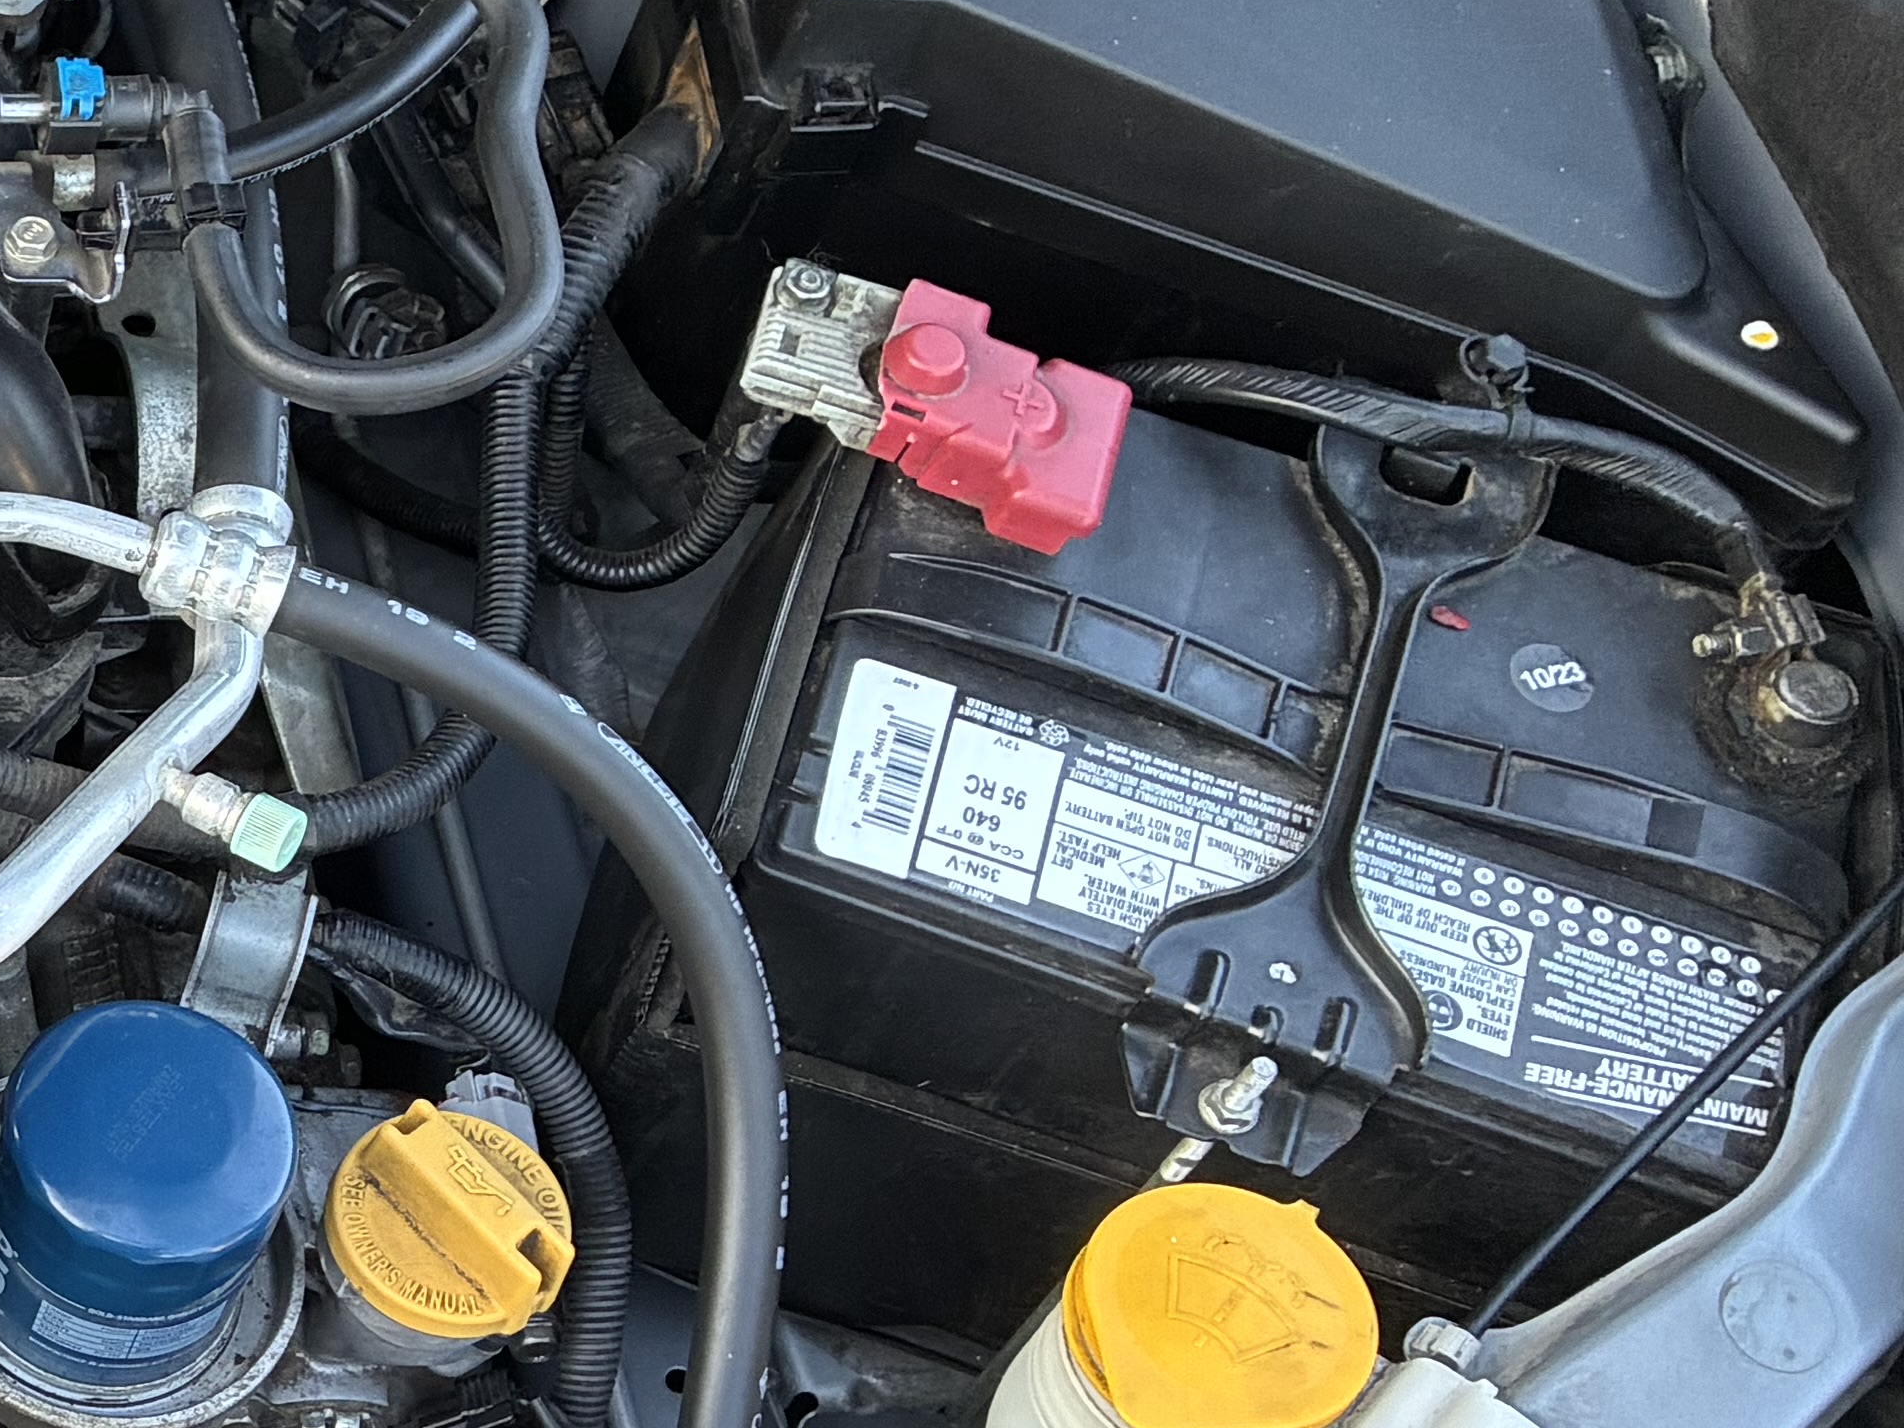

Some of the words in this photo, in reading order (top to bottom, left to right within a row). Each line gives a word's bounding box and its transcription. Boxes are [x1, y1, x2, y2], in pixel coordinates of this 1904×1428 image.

[297, 565, 350, 595] EH
[1519, 657, 1588, 696] 10/23
[988, 713, 1034, 736] BATTERY
[992, 734, 1021, 751] 12V
[961, 772, 997, 801] RC
[999, 784, 1028, 810] 95
[960, 805, 1002, 832] 640
[1114, 817, 1146, 836] OPEN
[1146, 816, 1171, 832] NOT
[1146, 829, 1171, 844] NOT
[1173, 825, 1192, 840] DO
[987, 839, 1025, 860] CCA
[1053, 840, 1106, 868] MEDICAL
[1090, 840, 1121, 860] HELP
[1172, 837, 1190, 851] DO
[1202, 834, 1284, 870] NSTRUCTIONS.
[943, 853, 1001, 883] 35N-V
[1050, 853, 1074, 870] GET
[1231, 855, 1253, 871] ALL
[965, 885, 994, 902] PART
[1081, 873, 1128, 898] WATER.
[1077, 885, 1154, 919] MMEDIATELY
[1129, 888, 1161, 908] WITH
[1084, 900, 1116, 919] EYES
[1372, 903, 1396, 919] THE
[1396, 911, 1413, 925] OF
[1415, 906, 1431, 919] OF
[1117, 911, 1149, 931] LUSH
[1414, 917, 1438, 933] OUT
[1432, 912, 1471, 933] REACH
[1439, 926, 1469, 944] KEEP
[1397, 949, 1457, 977] BLINDNESS
[1458, 970, 1493, 989] CAUSE
[1494, 983, 1516, 997] CAN
[1447, 979, 1515, 1012] EXPLOSIVE
[1473, 1004, 1512, 1026] EYES.
[1464, 1017, 1510, 1042] SHIELD
[1596, 1025, 1668, 1058] PROPOSITION
[1594, 1055, 1698, 1092] ATTERY
[1522, 1060, 1769, 1128] MAINNANCE-FREE
[340, 1173, 366, 1211] SEE
[346, 1211, 401, 1285] OWNER'S
[399, 1277, 483, 1316] MANUAL
